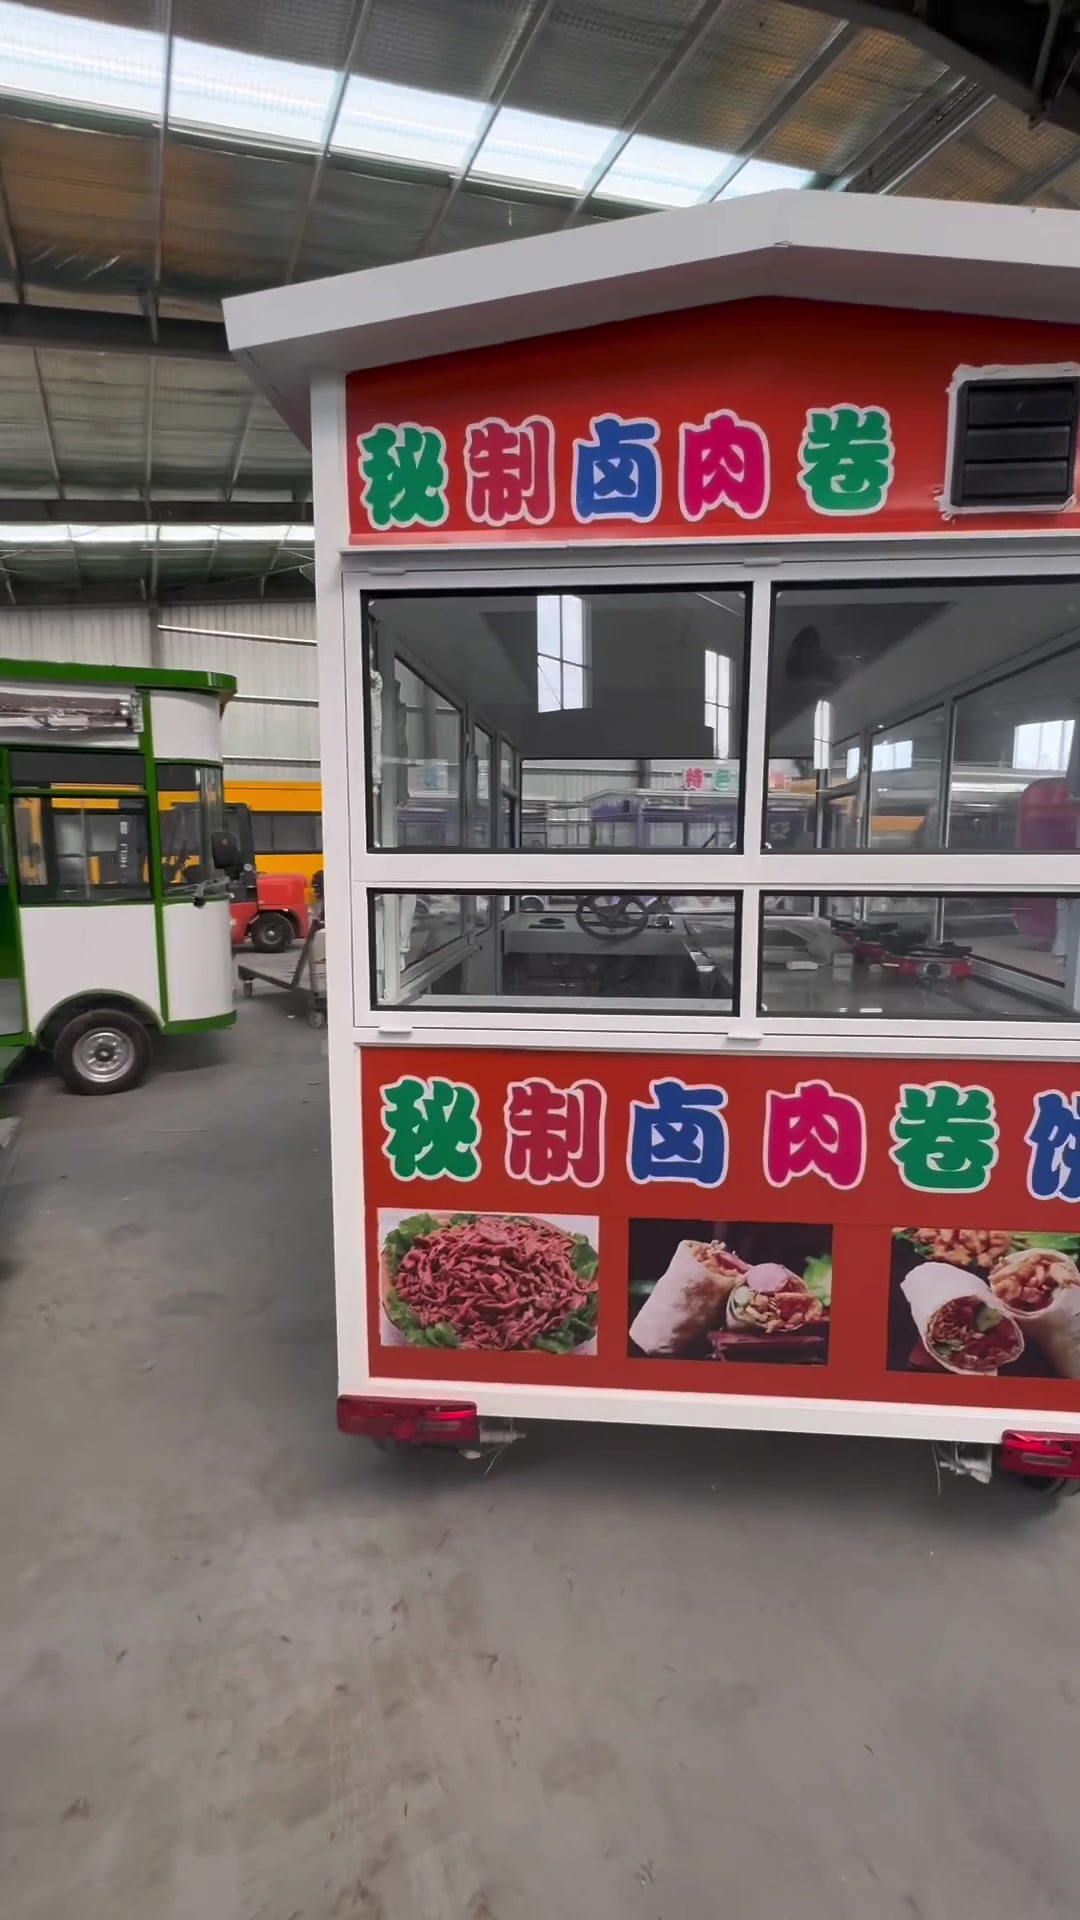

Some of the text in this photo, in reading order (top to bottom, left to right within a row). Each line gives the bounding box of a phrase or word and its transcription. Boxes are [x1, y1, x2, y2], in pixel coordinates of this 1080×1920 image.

[358, 404, 895, 529] 秘制卤肉卷
